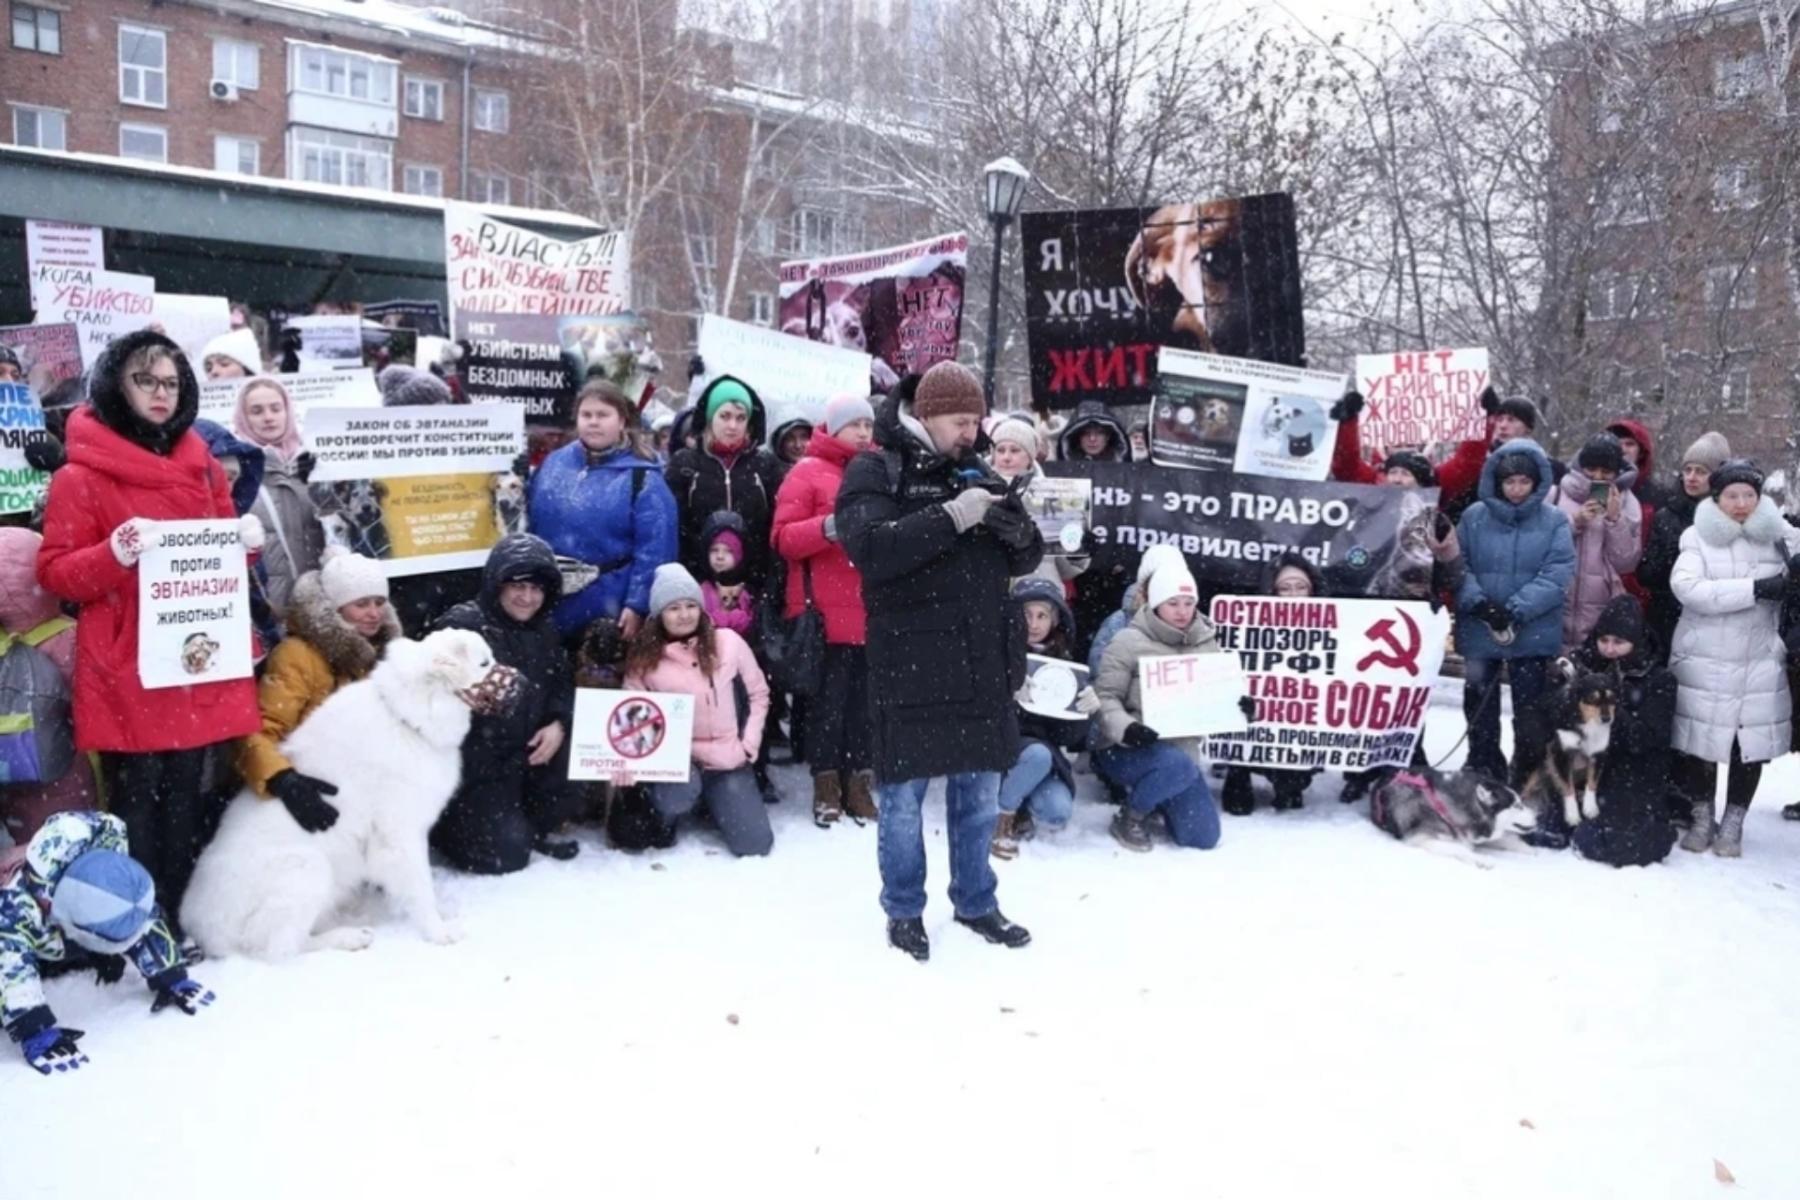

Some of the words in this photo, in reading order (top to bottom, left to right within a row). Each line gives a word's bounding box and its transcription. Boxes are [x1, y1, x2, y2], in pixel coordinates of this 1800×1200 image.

[1040, 238, 1063, 271] Я
[40, 266, 93, 284] КОГДА
[53, 286, 153, 315] УБИЙСТВО
[1044, 286, 1136, 323] ХОЧУ
[64, 310, 112, 325] СТАЛО
[468, 322, 496, 334] НЕТ
[469, 340, 560, 361] УБИЙСТВАМ
[1394, 352, 1453, 374] НЕТ
[468, 366, 564, 388] БЕЗДОМНЫХ
[1364, 370, 1486, 397] УБИЙСТВУ
[1366, 393, 1481, 422] ЖИВОТНЫХ
[346, 420, 389, 431] ЗАКОН
[393, 419, 411, 429] ОБ
[416, 418, 489, 429] ЭВТАНАЗИИ
[316, 434, 419, 447] ПРОТИВОРЕЧИТ
[424, 432, 514, 443] КОНСТИТУЦИИ
[373, 449, 394, 459] МЫ
[398, 447, 448, 458] ПРОТИВ
[1163, 491, 1221, 516] это
[1229, 492, 1355, 529] ПРАВО,
[1116, 526, 1330, 567] привилегя!
[170, 557, 221, 576] против
[151, 577, 239, 600] ЭВТАНАЗИИ
[156, 602, 233, 625] животных!
[1214, 599, 1337, 629] ОСТАНИНА
[1215, 626, 1239, 649] НЕ
[1245, 628, 1337, 650] ПОЗОРЬ
[1146, 658, 1198, 688] НЕТ
[1224, 649, 1336, 675] ПРФ!
[1325, 680, 1430, 730] СОБАК
[1278, 728, 1360, 747] ПРОБЛЕМОЙ
[1208, 742, 1244, 761] НАД
[1248, 745, 1327, 765] ДЕТЬМИ
[1329, 750, 1341, 765] В
